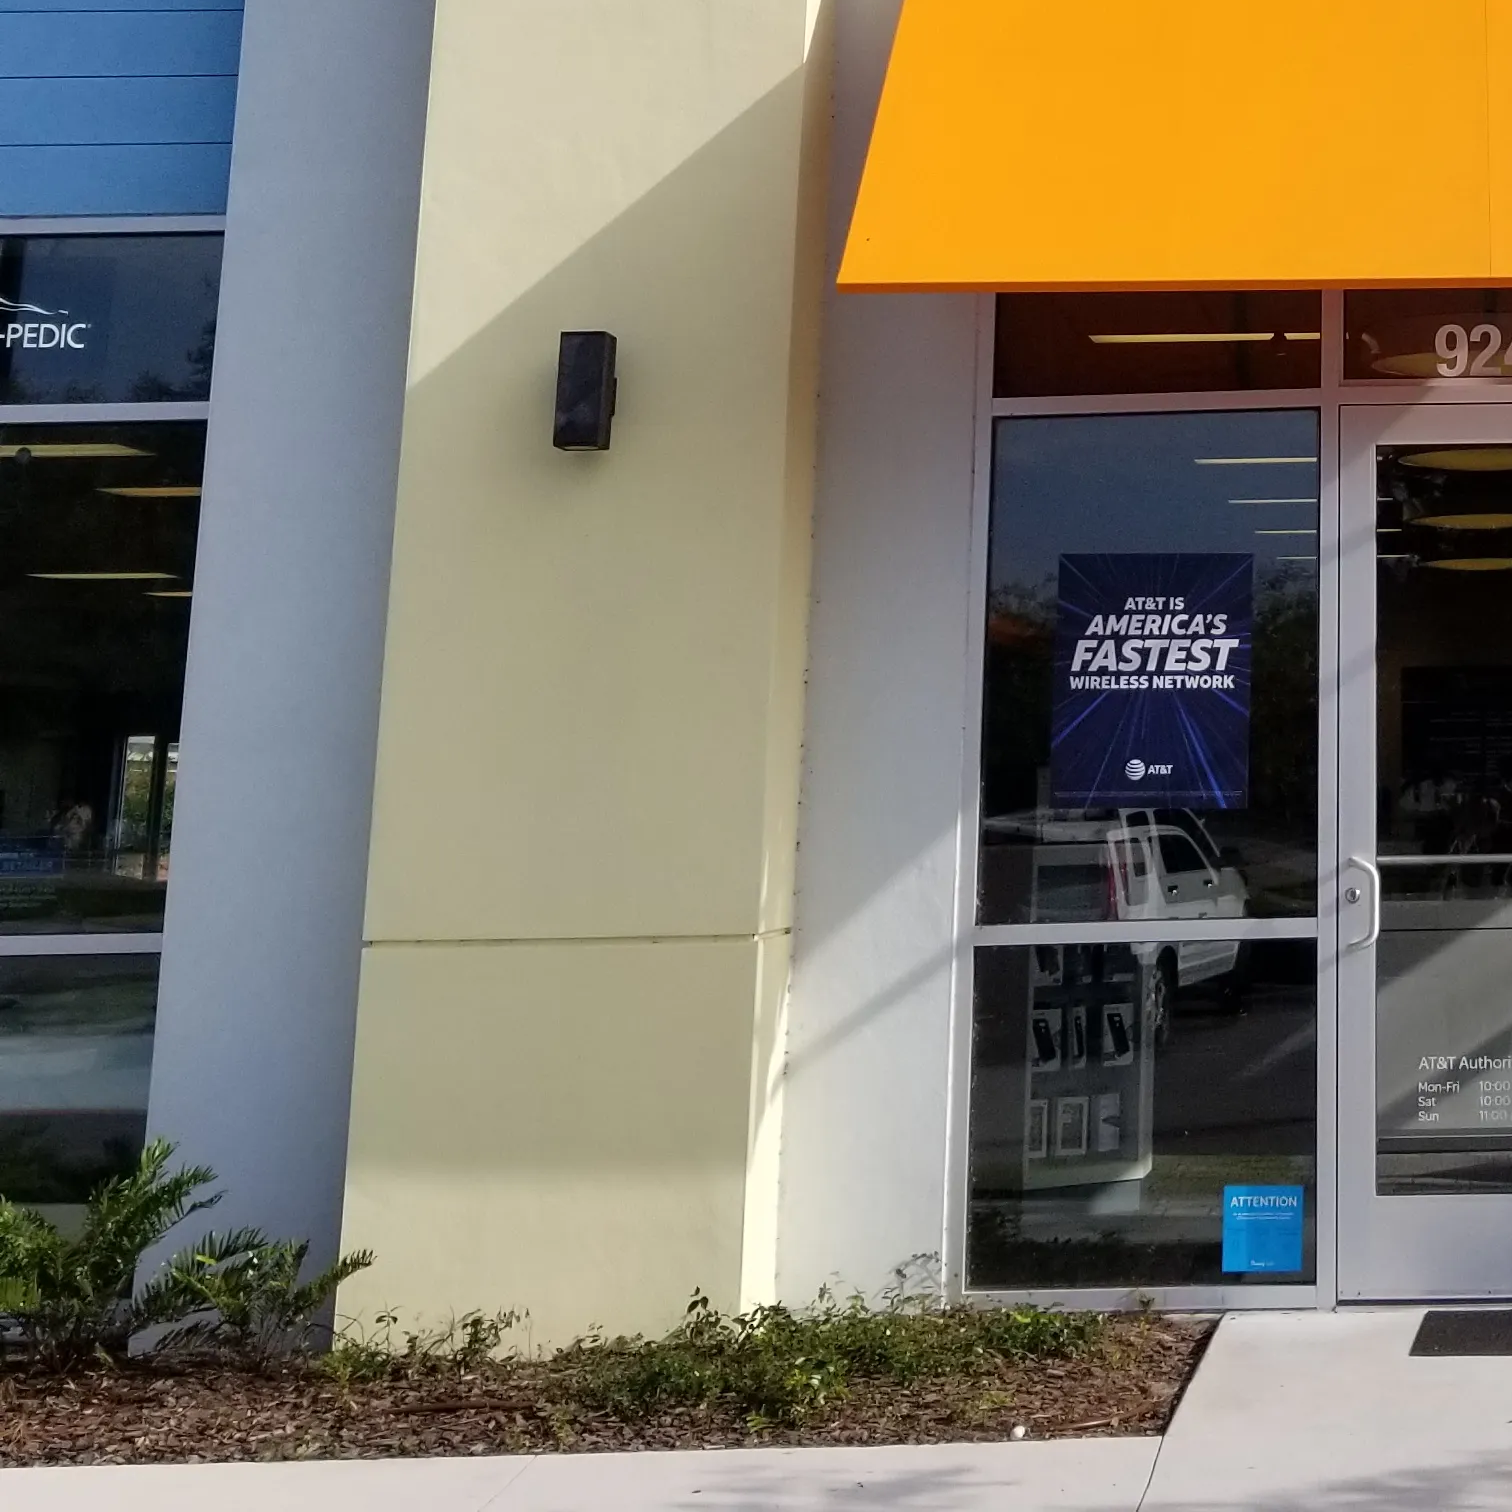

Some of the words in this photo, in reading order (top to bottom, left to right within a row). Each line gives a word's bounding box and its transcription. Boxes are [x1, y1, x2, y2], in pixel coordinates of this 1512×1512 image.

[1124, 597, 1166, 610] AT&T
[1169, 597, 1184, 610] IS
[1071, 639, 1240, 672] FASTEST
[1069, 675, 1149, 690] WIRELESS
[1152, 675, 1235, 689] NETWORK
[1148, 764, 1173, 775] AT&T
[1418, 1056, 1457, 1070] AT&T
[1418, 1081, 1460, 1093] Mon-Fri
[1479, 1080, 1511, 1092] 10:00
[1418, 1096, 1437, 1107] Sat
[1479, 1095, 1511, 1107] 10:00
[1418, 1110, 1440, 1121] Sun
[1230, 1196, 1297, 1208] ATTENTION
